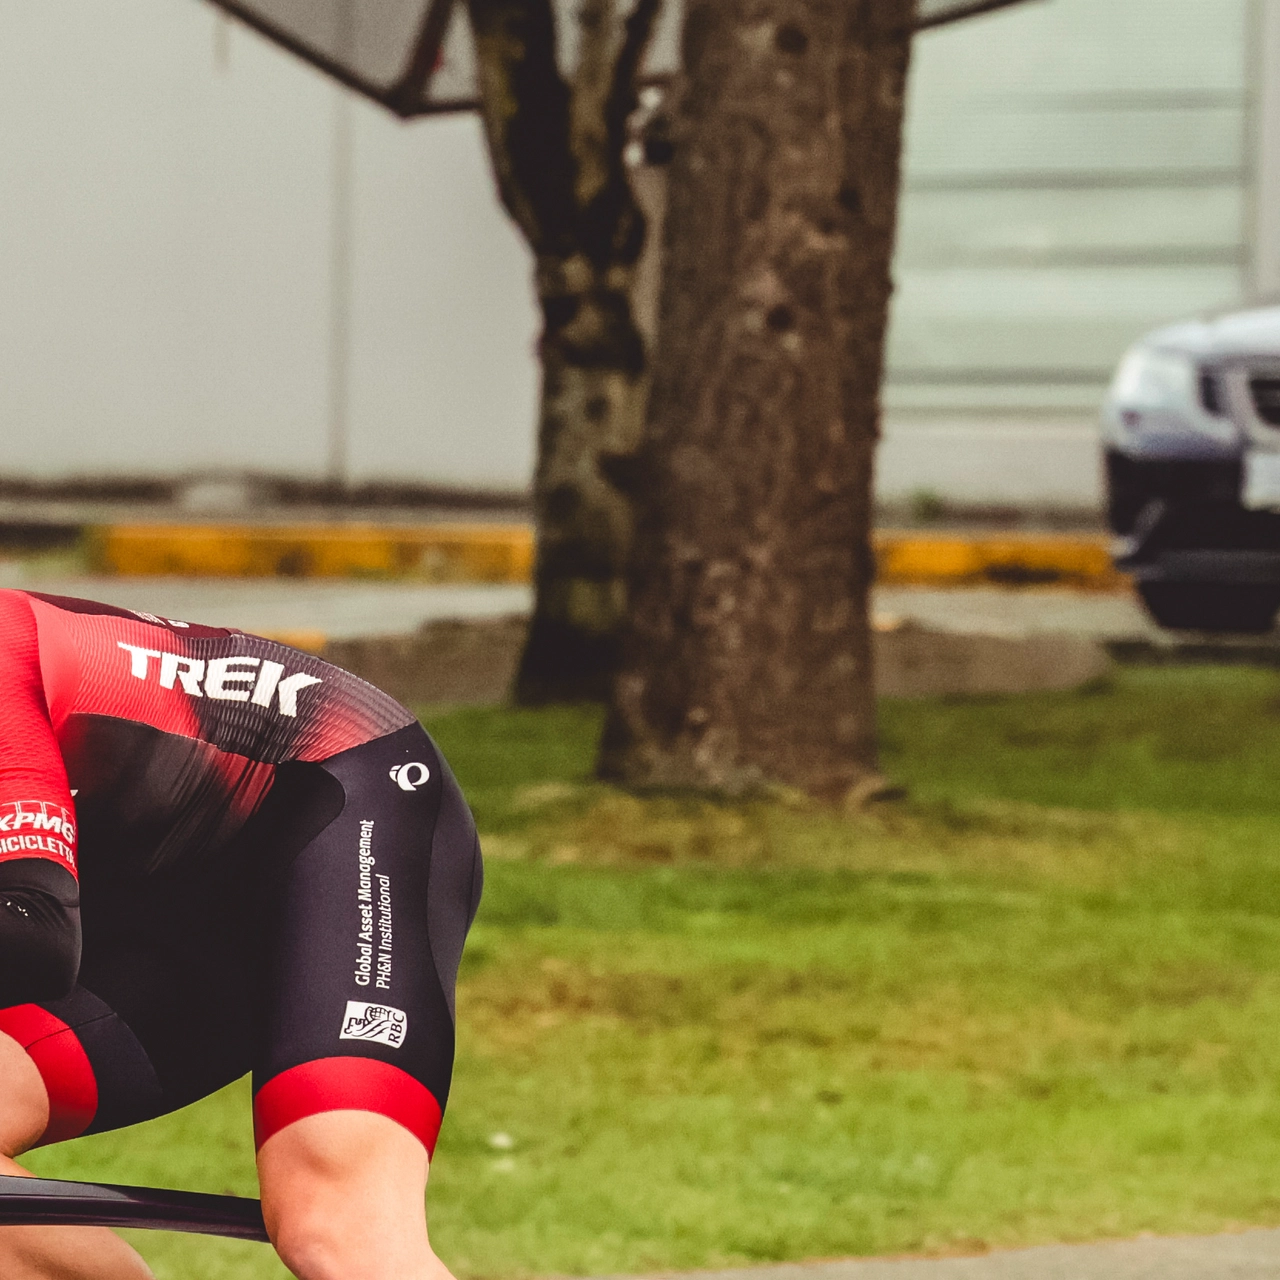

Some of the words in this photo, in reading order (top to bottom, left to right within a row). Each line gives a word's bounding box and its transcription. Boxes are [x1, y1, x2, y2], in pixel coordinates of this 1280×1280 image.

[117, 641, 323, 718] TREK
[357, 819, 376, 901] Management
[358, 904, 373, 941] Asset
[375, 873, 392, 951] Institutional
[354, 942, 372, 987] Global
[375, 952, 392, 990] PH&N
[387, 1011, 405, 1044] RBC
